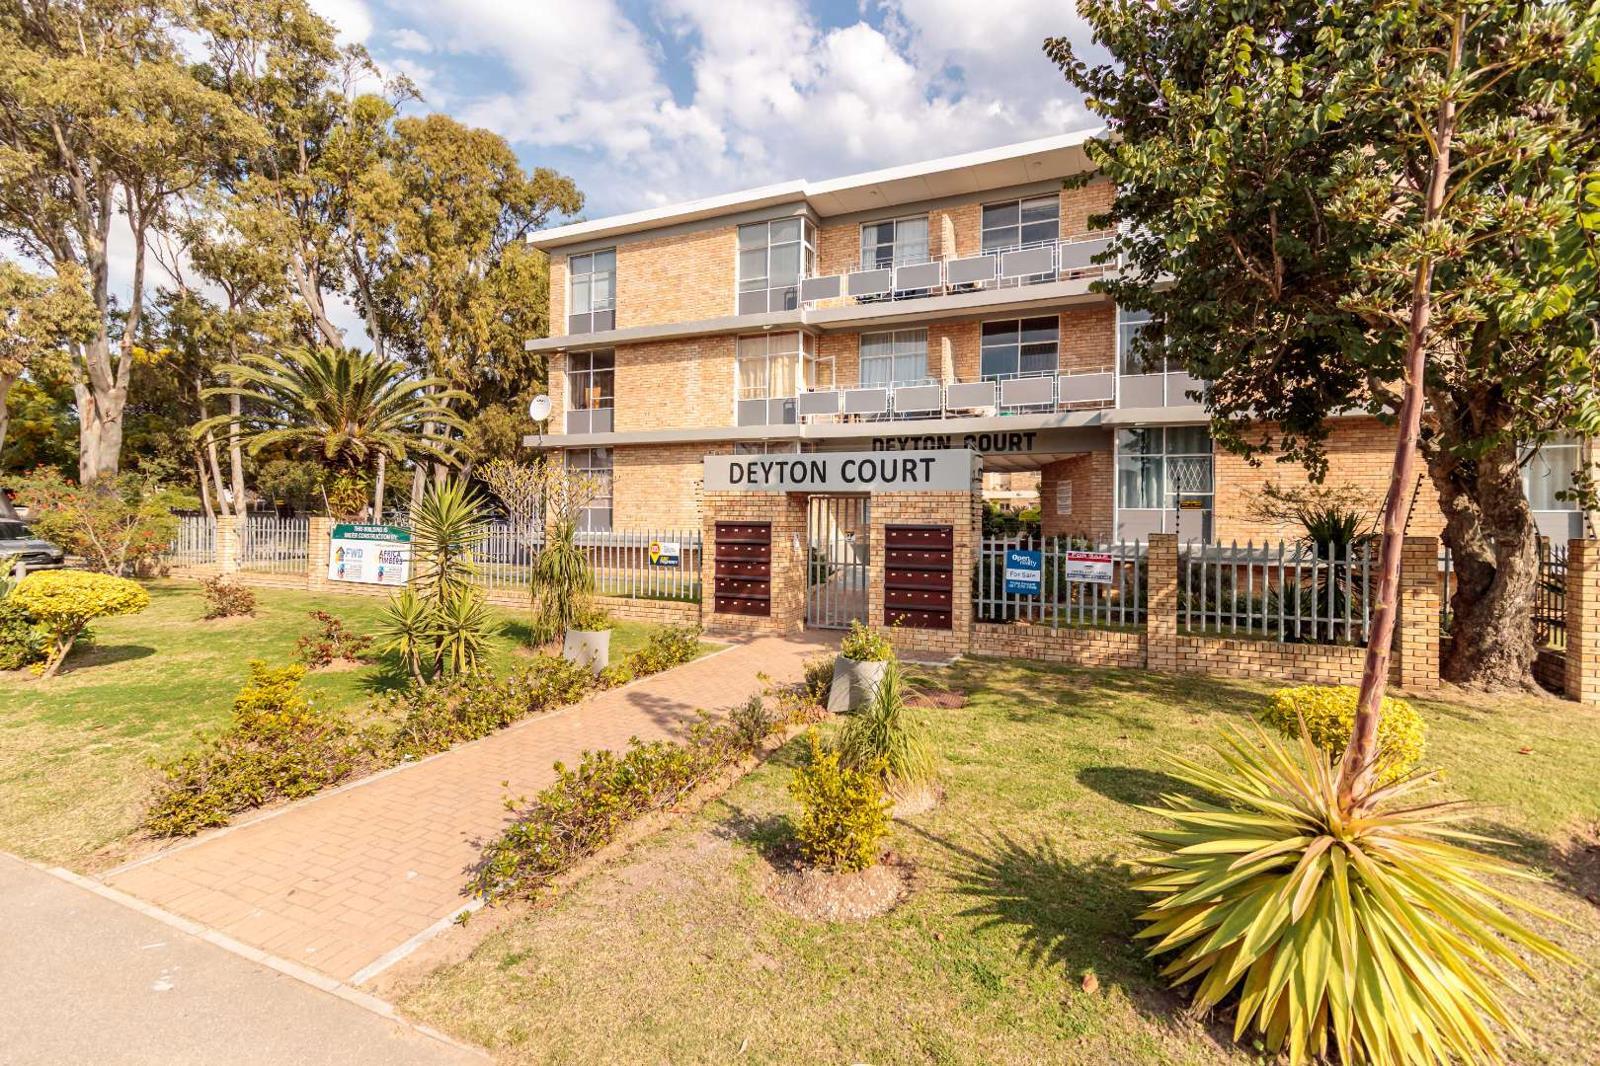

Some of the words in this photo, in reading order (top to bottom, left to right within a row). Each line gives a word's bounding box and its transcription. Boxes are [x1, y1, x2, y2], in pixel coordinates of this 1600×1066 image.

[872, 436, 951, 451] DEYTON
[964, 432, 1037, 451] COURT
[729, 460, 827, 484] DEYTON
[840, 457, 936, 483] COURT
[345, 548, 364, 559] FWD
[379, 550, 401, 558] AFRICA
[1011, 554, 1030, 562] Open
